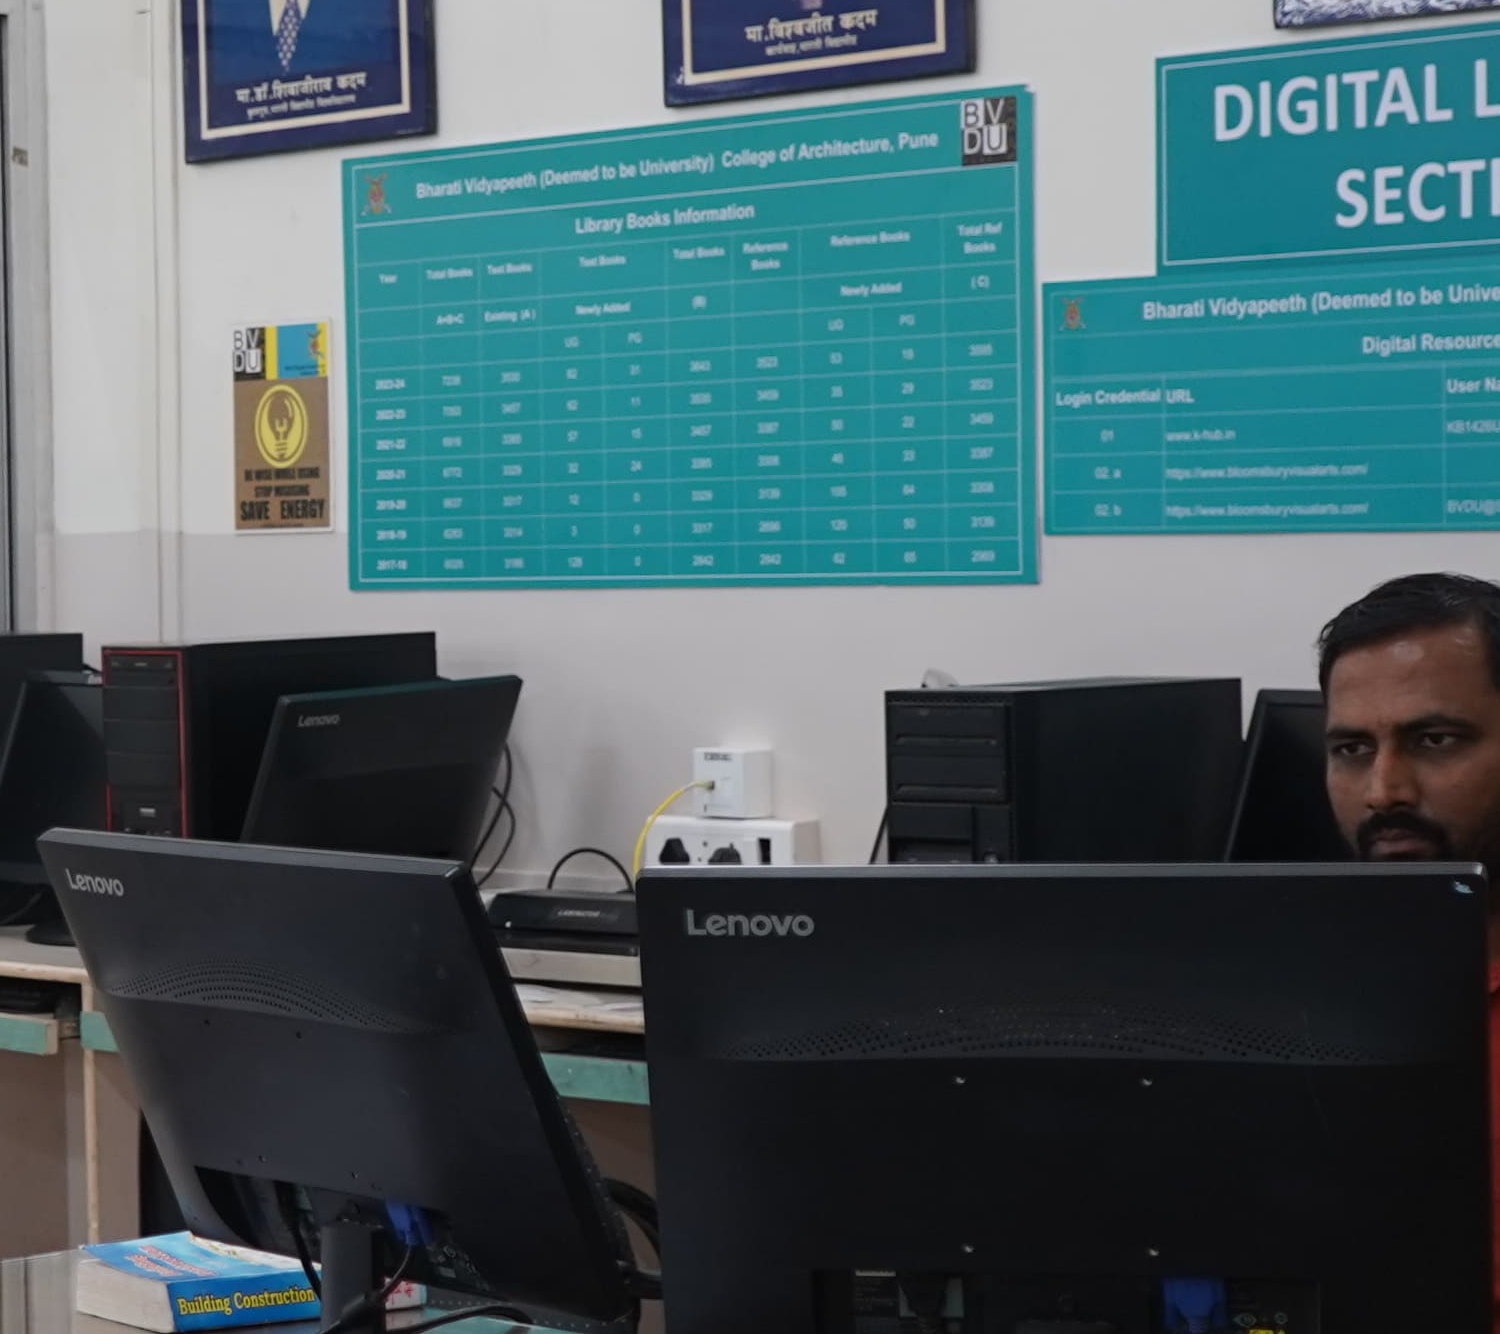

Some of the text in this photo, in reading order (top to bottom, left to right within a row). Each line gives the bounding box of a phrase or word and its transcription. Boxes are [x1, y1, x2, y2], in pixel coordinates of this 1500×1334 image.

[838, 8, 878, 31] कदम
[1211, 62, 1453, 142] DIGITAL
[416, 131, 939, 199] Bharati Vidyapeeth (Deemed to be University) College of Architecture, Pune
[575, 203, 755, 235] Library Books Information
[1142, 298, 1205, 321] Bharati
[1208, 293, 1307, 319] Vidyapeeth
[1311, 287, 1392, 315] (Deemed
[1396, 287, 1415, 308] to
[1419, 285, 1443, 306] be
[1361, 333, 1417, 357] Digital
[1055, 388, 1162, 409] Login Credential
[1165, 388, 1195, 405] URL
[1446, 376, 1481, 394] User
[240, 497, 325, 522] SAVE ENERGY
[65, 868, 125, 898] Lenovo
[685, 908, 815, 937] Lenovo
[178, 1286, 316, 1316] Building Construction
